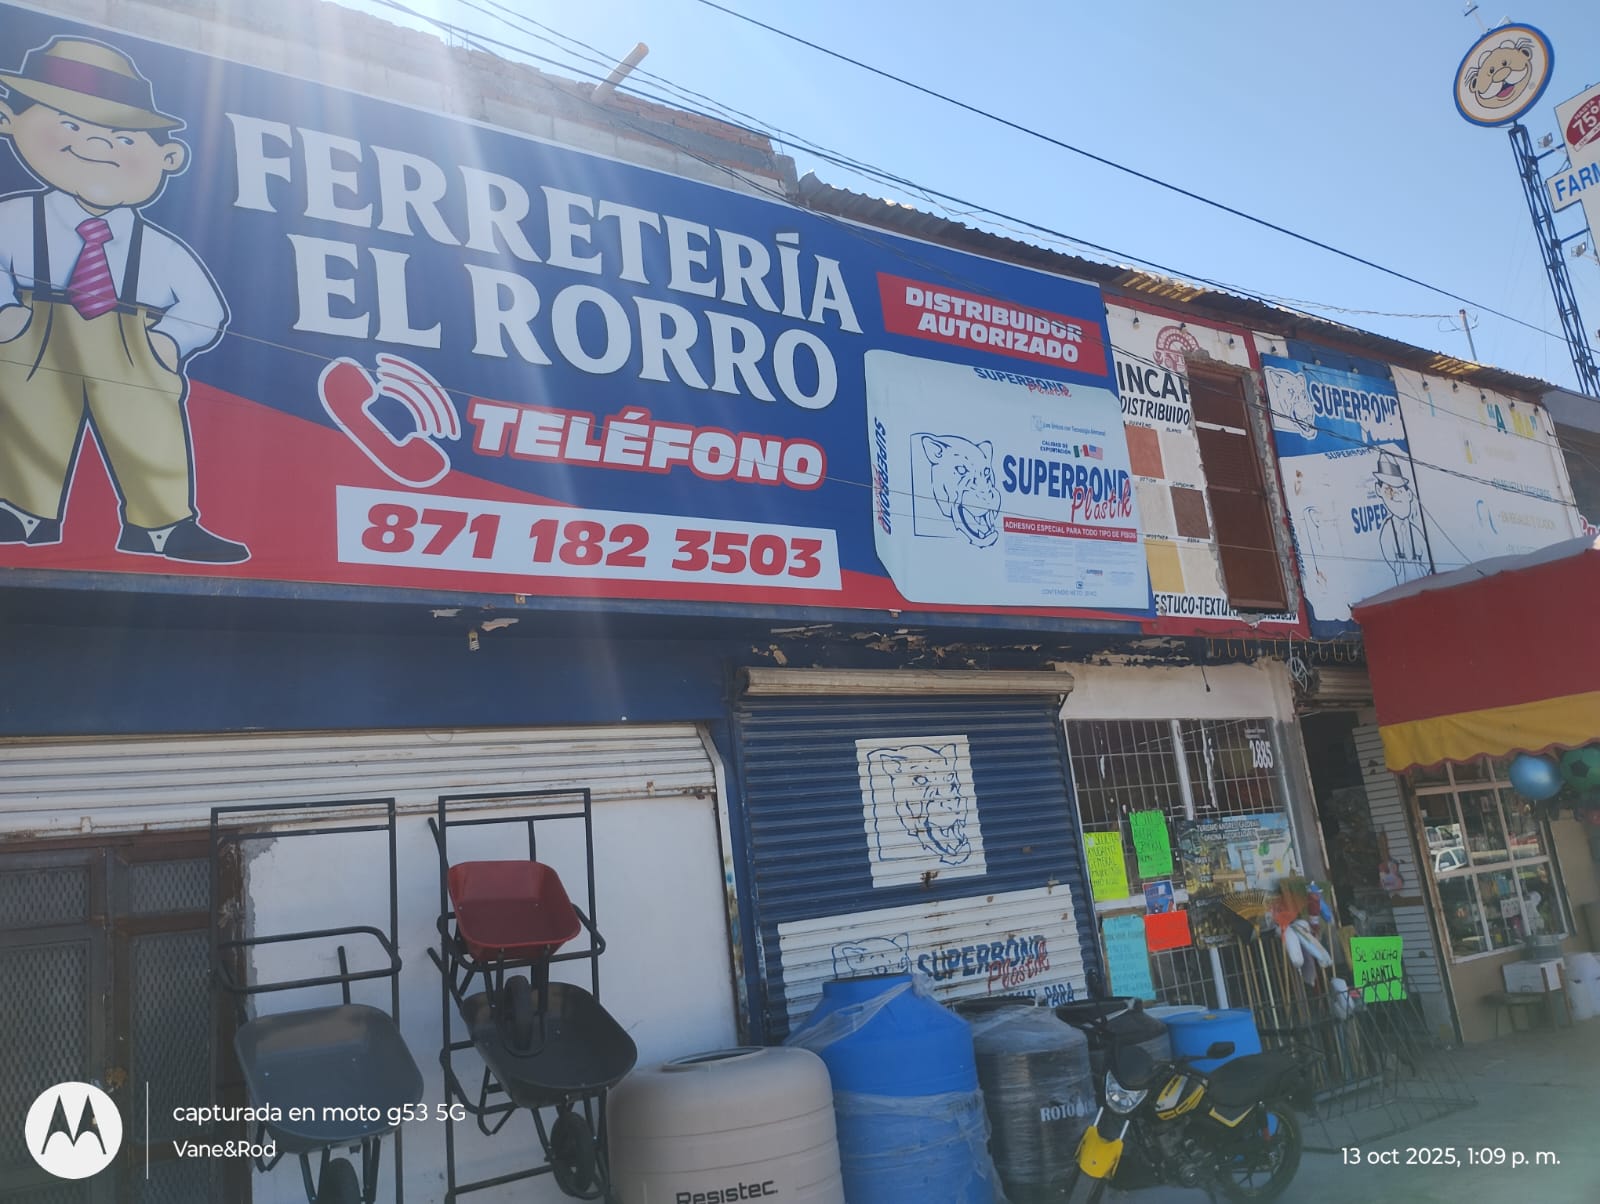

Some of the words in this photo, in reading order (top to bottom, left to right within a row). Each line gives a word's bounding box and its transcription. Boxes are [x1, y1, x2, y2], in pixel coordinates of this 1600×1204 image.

[224, 112, 864, 335] FERRETERÍA
[287, 234, 441, 348] EL
[464, 263, 838, 410] RORRO
[905, 286, 1082, 344] DISTRIBUIDOR
[917, 316, 1079, 364] AUTORIZADO
[974, 367, 1070, 394] SUPERBOND
[469, 398, 825, 488] TELÉFONO
[1003, 454, 1131, 504] SUPERBOND
[1070, 479, 1132, 523] Plastik
[361, 502, 501, 560] 871
[529, 518, 651, 568] 182
[671, 528, 822, 579] 3503
[1036, 524, 1065, 534] ESPECIAL
[1066, 527, 1082, 535] PARA
[1082, 528, 1097, 537] TODO
[1099, 529, 1111, 537] TIPO
[1112, 530, 1120, 538] DE
[917, 934, 1047, 981] SUPERBOND
